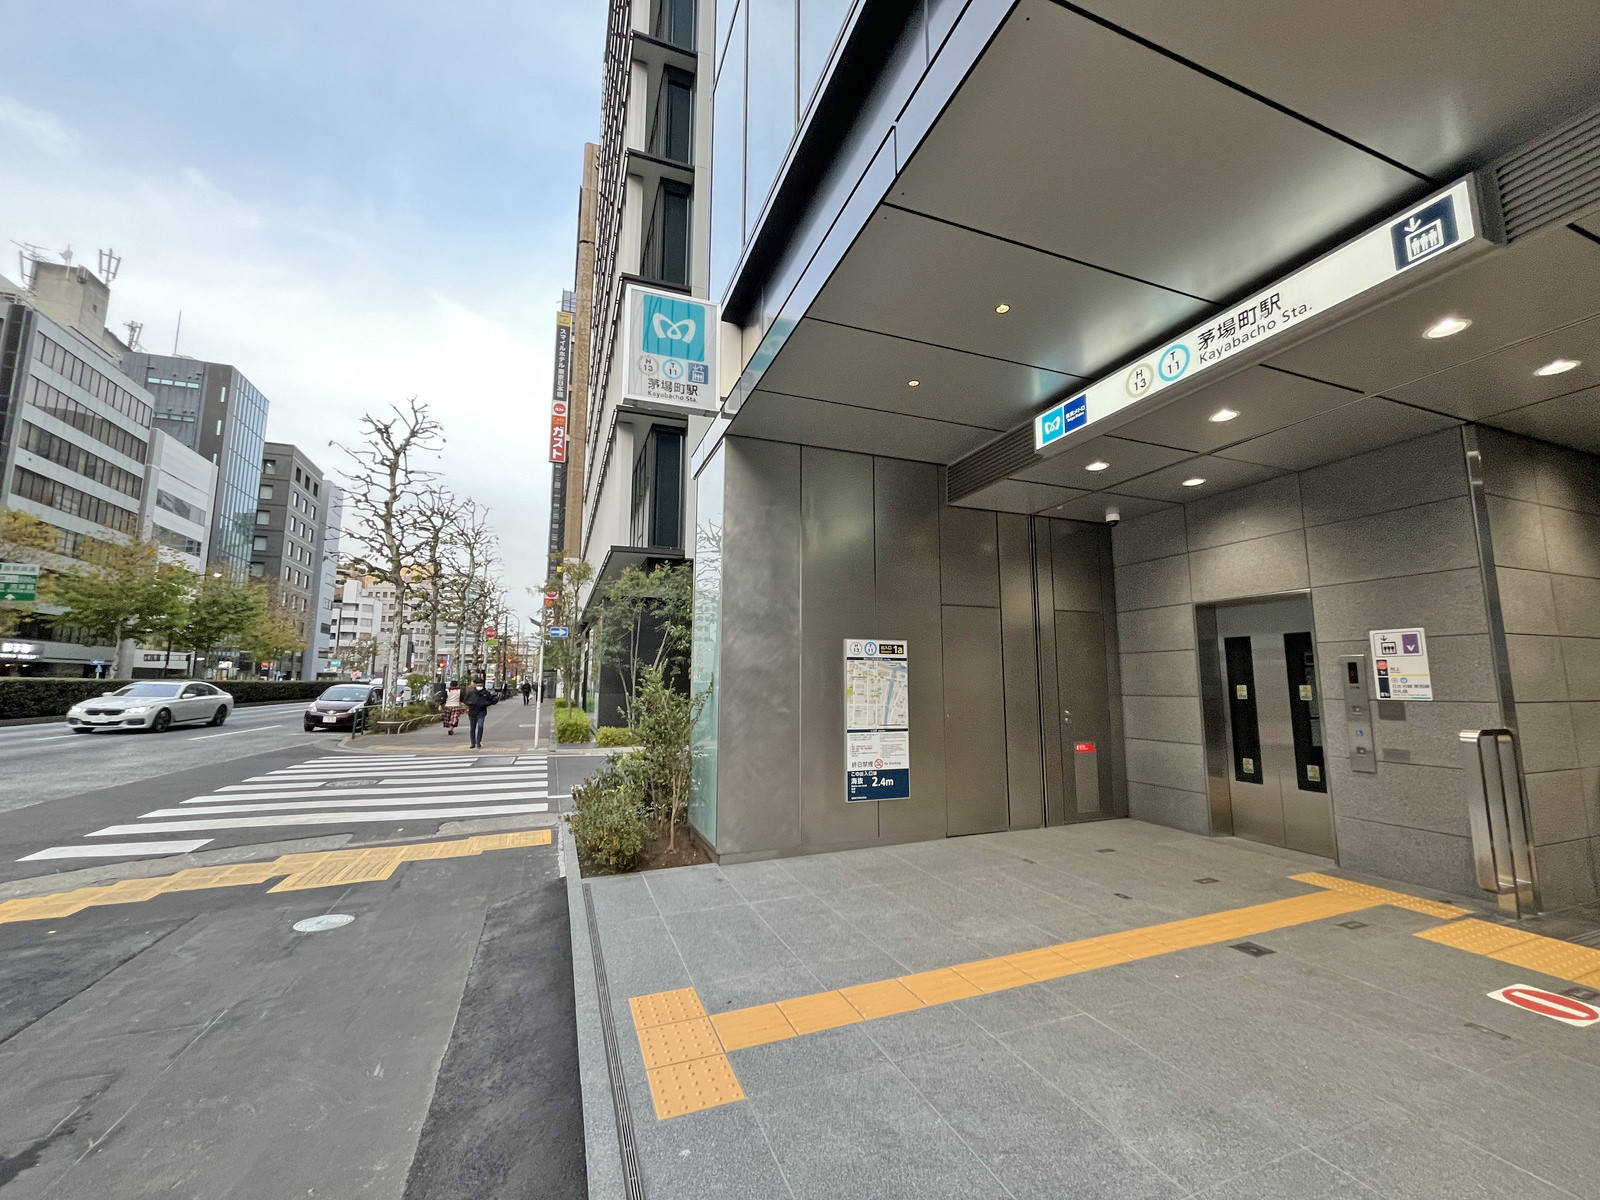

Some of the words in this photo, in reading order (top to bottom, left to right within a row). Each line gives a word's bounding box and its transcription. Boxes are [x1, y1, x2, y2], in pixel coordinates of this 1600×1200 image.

[1198, 292, 1282, 351] 茅場町駅
[1200, 320, 1277, 364] Kayabacho
[1282, 304, 1313, 323] Sta.
[1170, 351, 1176, 361] T
[668, 368, 677, 376] 11
[1168, 360, 1180, 374] 11
[1136, 368, 1143, 379] H
[648, 378, 698, 396] 茅場町駅
[1134, 377, 1147, 391] 13
[647, 390, 684, 401] Kayabacho
[553, 426, 564, 459] ガスト
[893, 645, 903, 654] 1a
[871, 776, 894, 787] 2.4m
